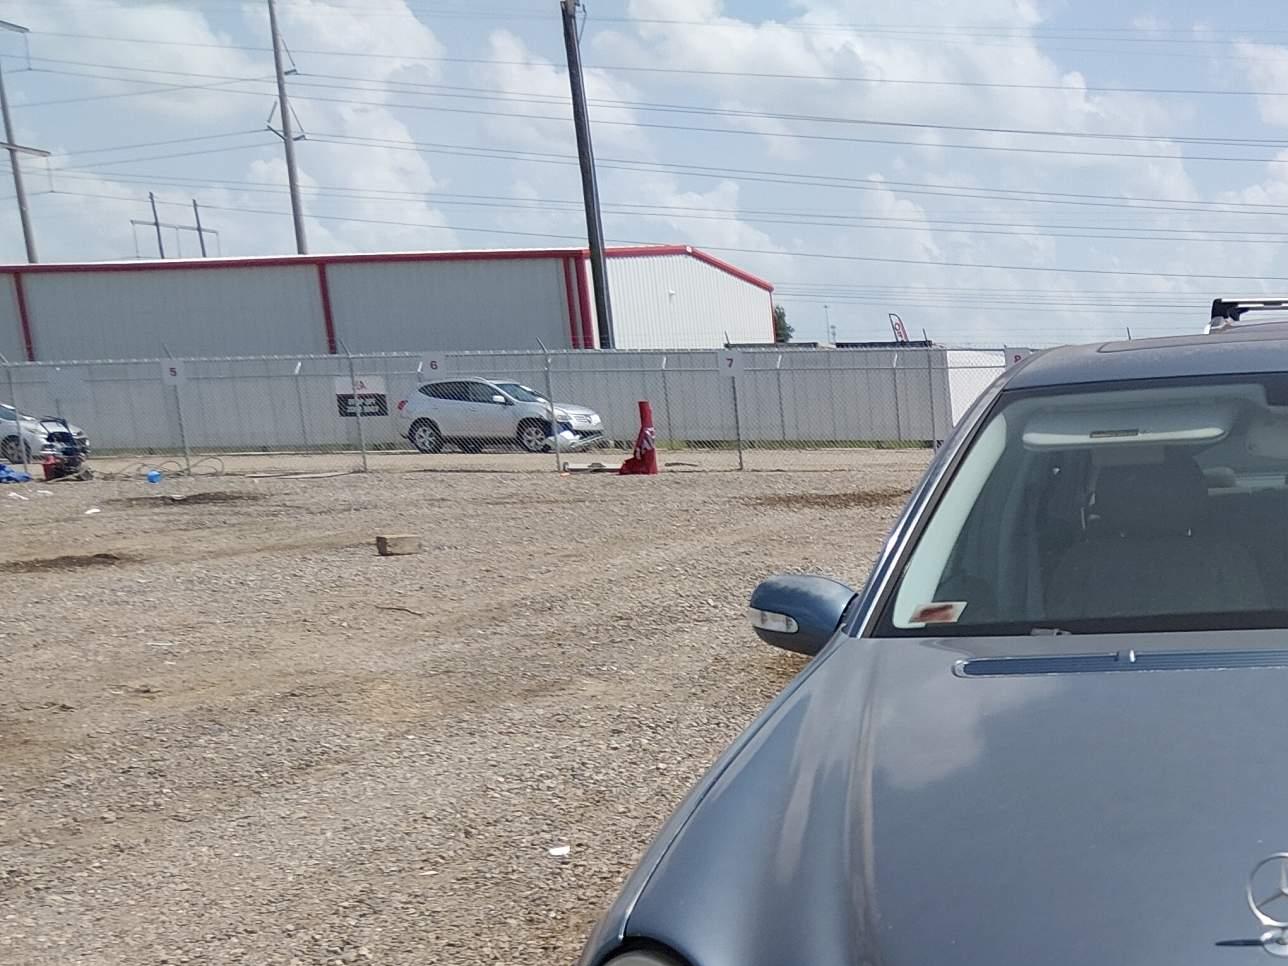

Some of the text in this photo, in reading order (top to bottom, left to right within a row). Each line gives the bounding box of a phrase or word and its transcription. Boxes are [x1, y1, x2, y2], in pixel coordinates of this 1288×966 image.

[430, 360, 438, 370] 6
[726, 357, 734, 368] 7
[169, 367, 177, 377] 5
